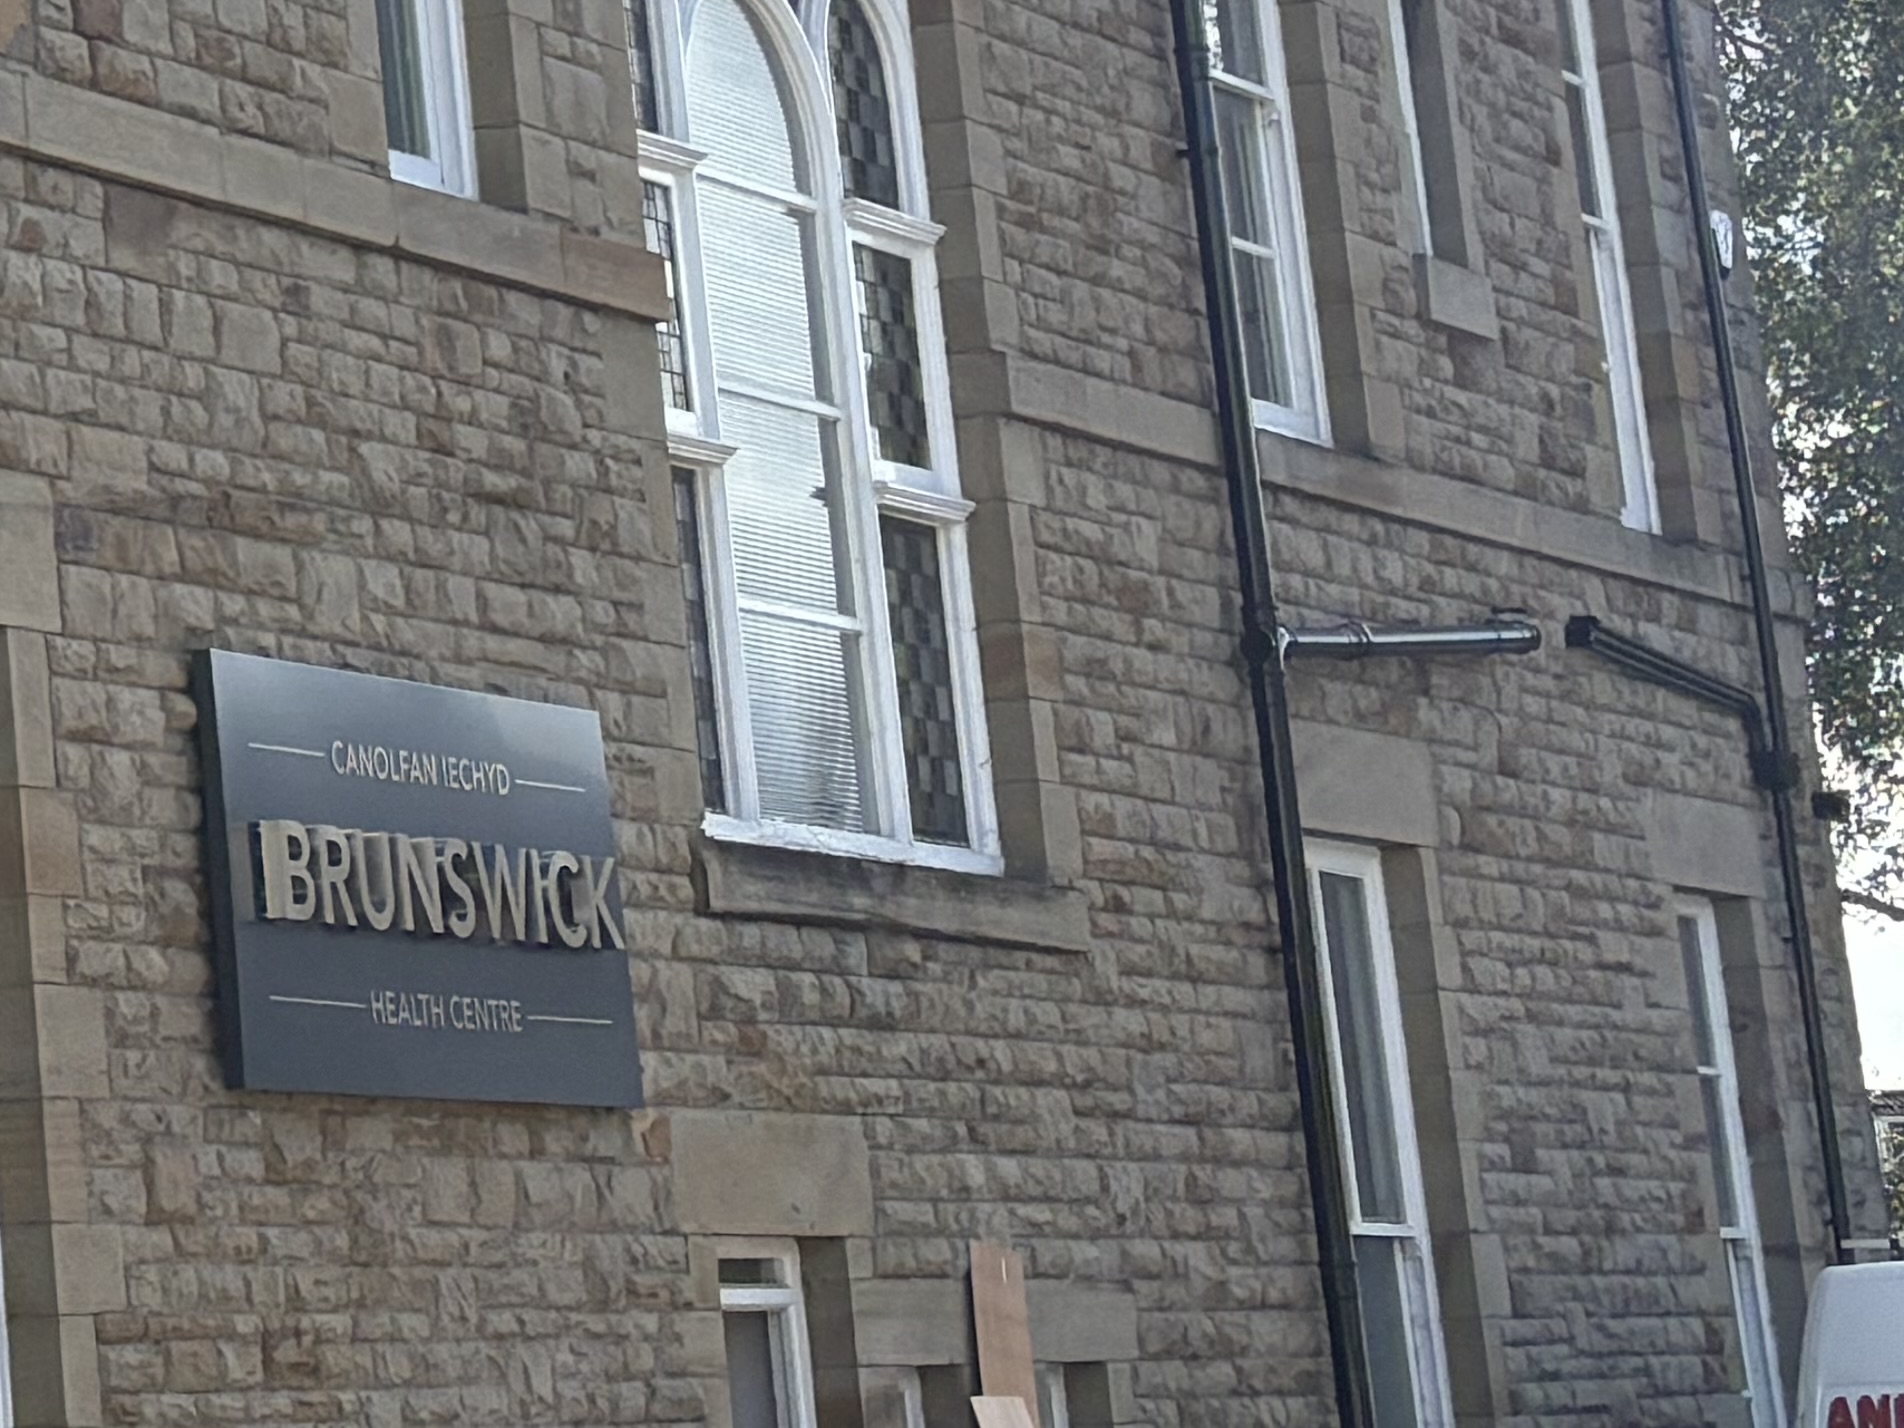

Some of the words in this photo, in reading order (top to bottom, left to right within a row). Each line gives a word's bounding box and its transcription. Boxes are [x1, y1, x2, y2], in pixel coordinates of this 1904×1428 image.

[331, 740, 437, 786] CANOLFAN
[442, 755, 510, 795] IECHYD
[261, 819, 625, 949] BRUNSWICK
[370, 990, 444, 1028] HEALTH
[450, 995, 523, 1032] CENTRE
